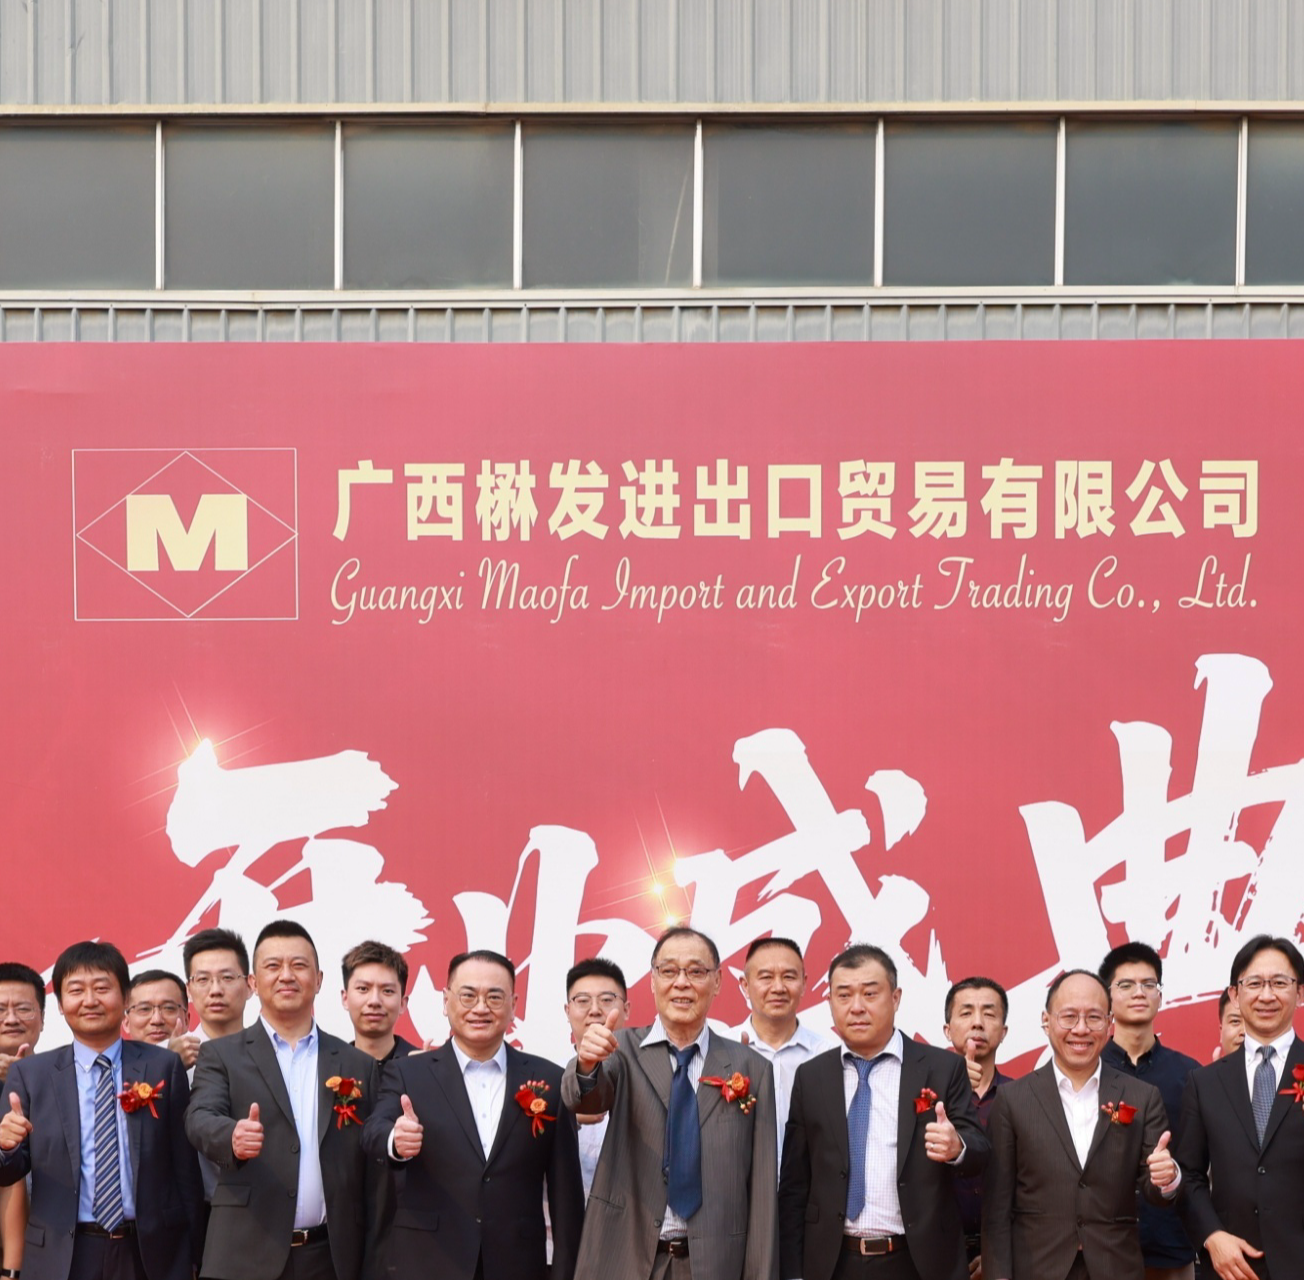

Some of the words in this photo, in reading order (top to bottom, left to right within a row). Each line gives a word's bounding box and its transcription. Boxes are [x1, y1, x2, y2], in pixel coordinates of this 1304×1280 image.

[329, 556, 466, 626] Guangxi
[477, 553, 590, 625] Maofa
[600, 554, 724, 625] Import
[735, 553, 802, 610] and
[809, 554, 924, 624] Export
[932, 552, 1075, 623] Trading
[1086, 554, 1161, 613] Co.,
[1177, 552, 1259, 610] Ltd.
